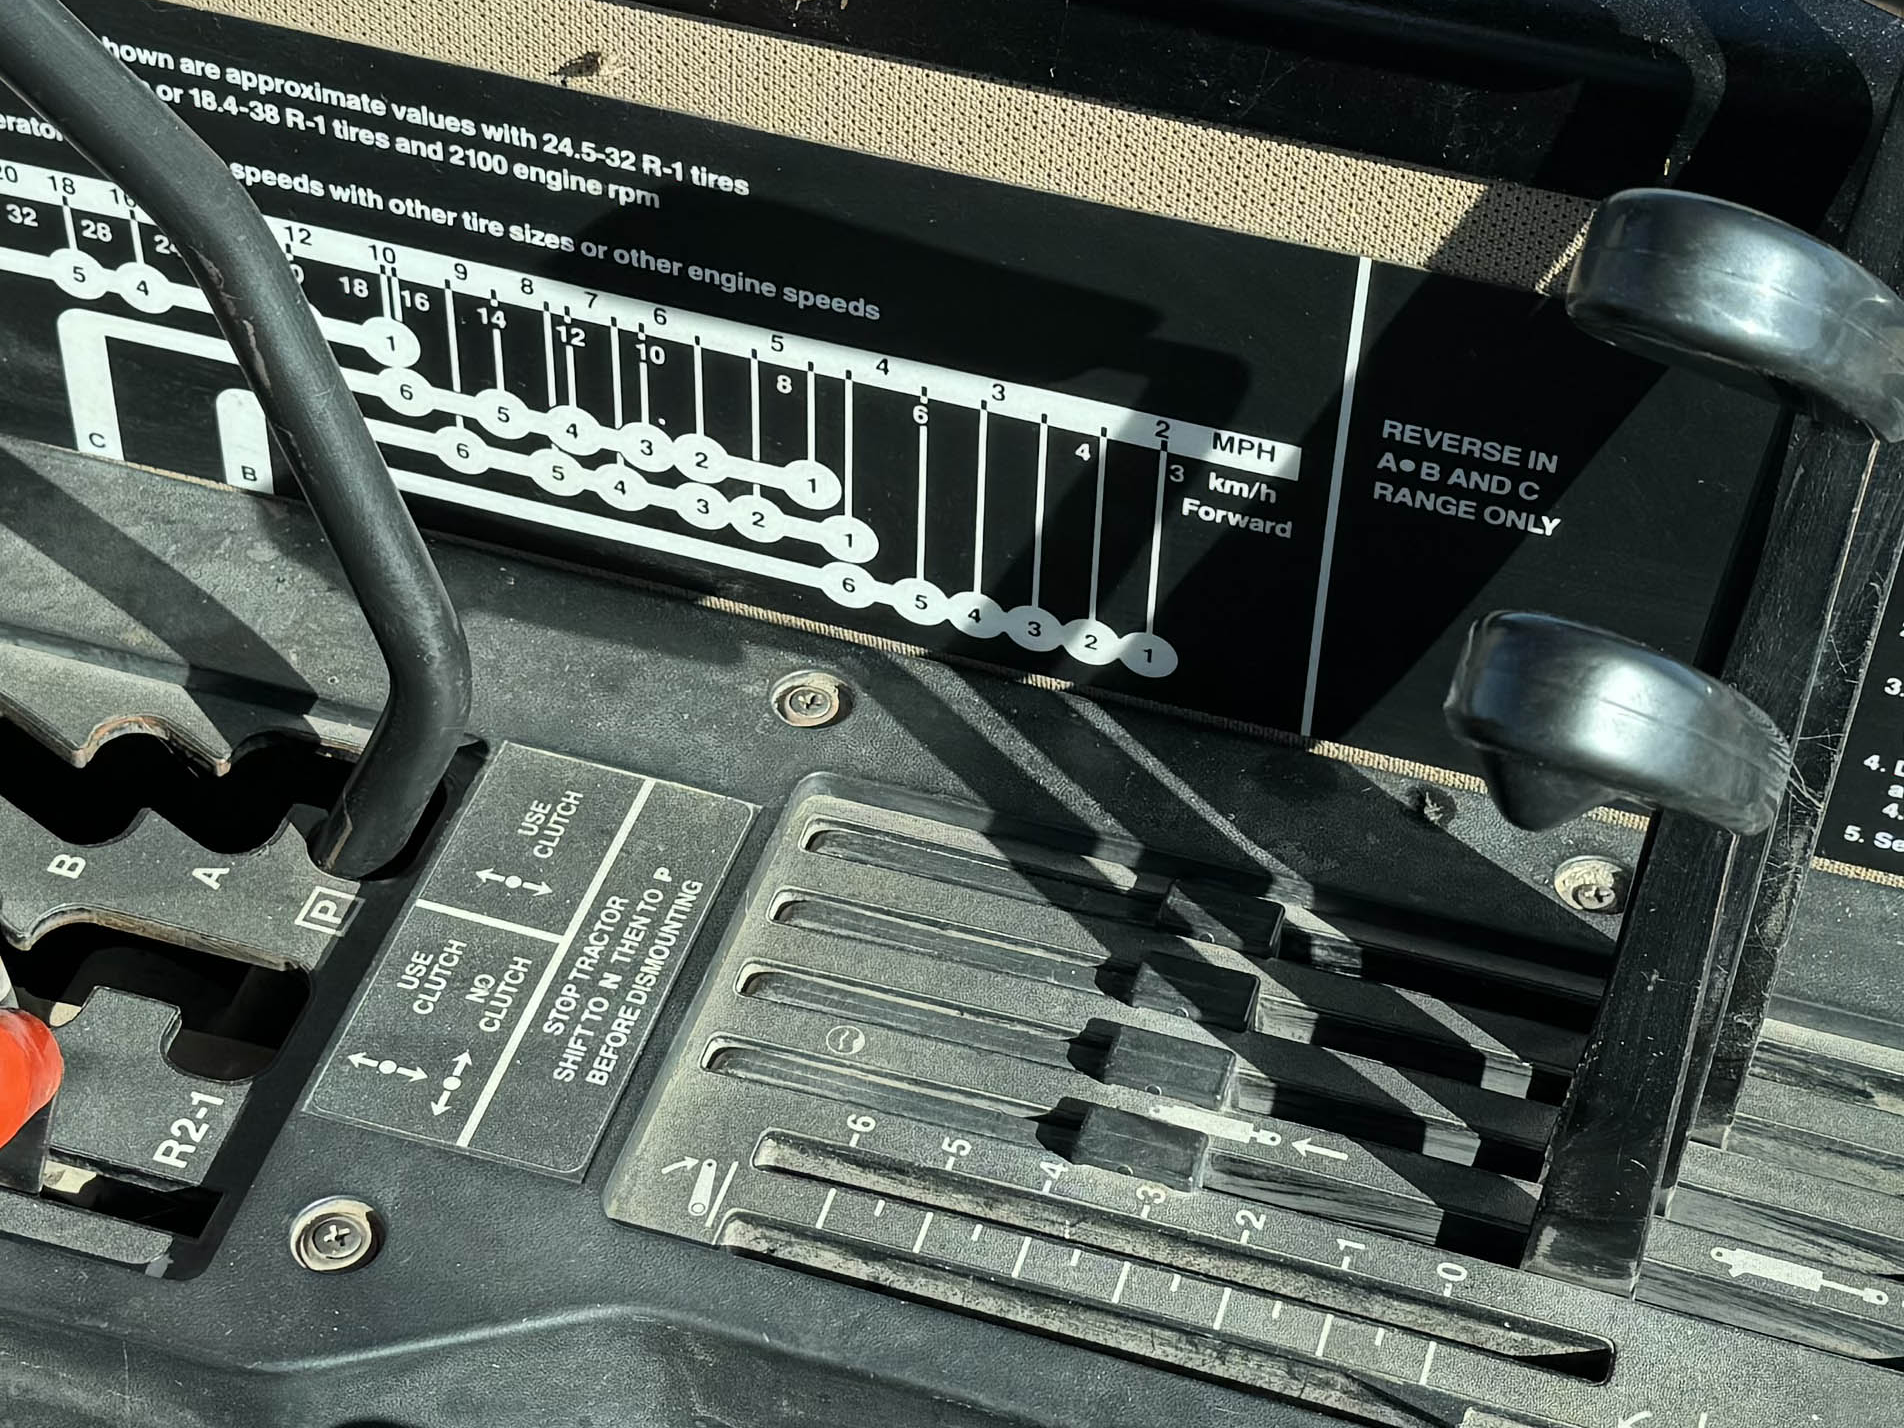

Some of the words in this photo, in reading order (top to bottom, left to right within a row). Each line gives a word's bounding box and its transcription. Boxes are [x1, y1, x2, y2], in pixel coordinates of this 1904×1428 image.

[105, 35, 175, 70] hown
[178, 56, 221, 80] are
[224, 66, 387, 116] approximate
[390, 102, 476, 136] values
[479, 122, 537, 150] with
[541, 132, 636, 171] 24.5-32
[641, 153, 683, 182] R-1
[689, 164, 749, 195] tires
[157, 83, 184, 111] or
[187, 87, 280, 125] 18.4-38
[284, 106, 326, 135] R-1
[331, 118, 390, 149] tires
[394, 136, 444, 161] and
[448, 144, 508, 175] 2100
[512, 161, 603, 196] engine
[607, 182, 659, 208] rpm
[229, 161, 325, 197] speeds
[327, 183, 383, 210] with
[387, 197, 458, 226] other
[460, 210, 504, 237] tire
[508, 222, 575, 252] sizes
[580, 240, 608, 259] or
[612, 248, 683, 276] other
[687, 264, 776, 297] engine
[782, 286, 880, 320] speeds
[7, 204, 39, 227] 32
[81, 219, 113, 243] 28
[339, 276, 369, 299] 18
[401, 289, 430, 313] 16
[477, 305, 506, 328] 14
[556, 324, 585, 347] 12
[636, 344, 666, 367] 10
[47, 175, 76, 196] 18
[286, 226, 312, 247] 12
[368, 244, 396, 265] 10
[455, 262, 468, 282] 9
[521, 277, 534, 297] 8
[585, 291, 598, 310] 7
[653, 307, 667, 327] 6
[770, 334, 784, 354] 5
[875, 358, 890, 375] 4
[991, 383, 1005, 402] 3
[1155, 421, 1171, 440] 2
[1213, 432, 1276, 462] MPH
[1381, 418, 1522, 466] REVERSE
[1527, 449, 1558, 473] IN
[1208, 473, 1277, 504] km/h
[1373, 480, 1477, 520] RANGE
[1483, 505, 1561, 536] ONLY
[1446, 467, 1512, 495] AND
[1517, 480, 1540, 500] C
[1181, 497, 1293, 539] Forward
[516, 799, 552, 836] USE
[532, 789, 584, 859] CLUTCH
[1843, 824, 1864, 843] 5.
[47, 854, 87, 880] B
[191, 864, 230, 890] A
[652, 865, 672, 882] P
[317, 900, 342, 925] P
[635, 887, 664, 912] TO
[609, 913, 652, 964] THEN
[395, 949, 434, 990] USE
[411, 934, 467, 1015] CLUTCH
[464, 973, 495, 1003] NO
[541, 982, 581, 1036] STOP
[566, 895, 629, 980] TRACTOR
[584, 1004, 641, 1086] BEFORE
[624, 879, 703, 1005] DISMOUNTING
[597, 971, 622, 990] N
[477, 955, 532, 1032] CLUTCH
[579, 996, 609, 1022] TO
[552, 1022, 594, 1083] SHIFT
[153, 1091, 224, 1168] R2-1
[848, 1114, 876, 1134] 6
[942, 1137, 971, 1157] 5
[1038, 1160, 1067, 1180] 4
[1137, 1185, 1166, 1206] 3
[1237, 1209, 1265, 1230] 2
[1338, 1238, 1366, 1253] 1
[1437, 1263, 1468, 1283] 0
